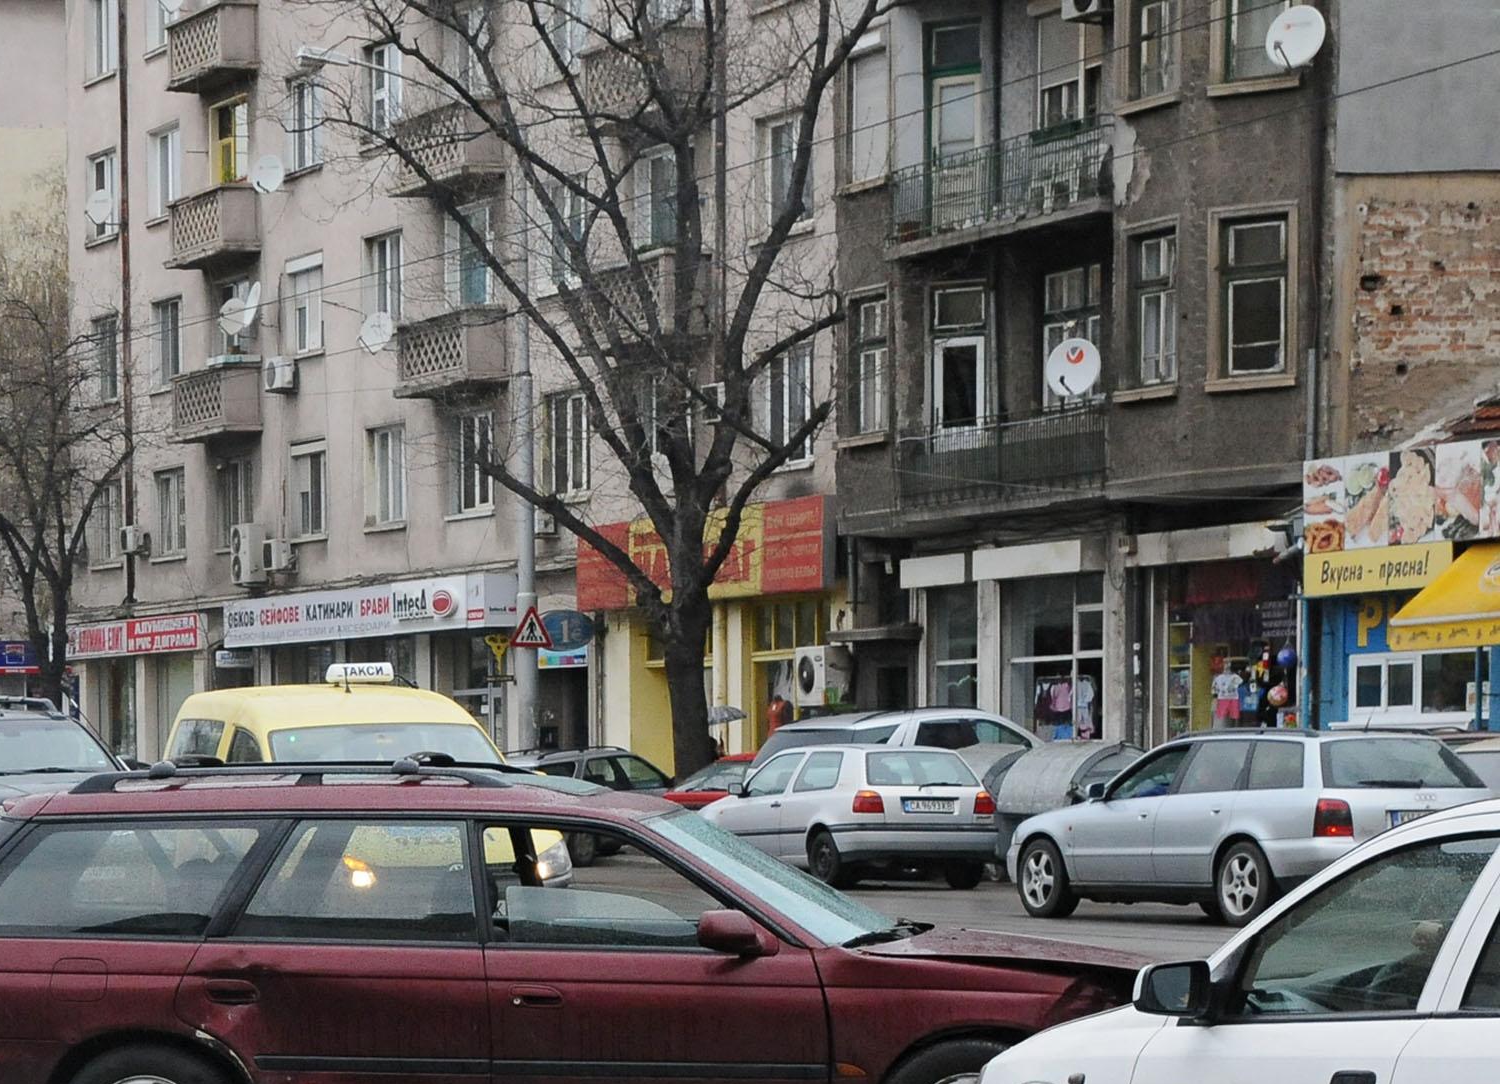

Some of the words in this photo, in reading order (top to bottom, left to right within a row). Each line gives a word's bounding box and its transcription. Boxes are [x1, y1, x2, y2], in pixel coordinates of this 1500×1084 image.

[1321, 560, 1363, 590] Вкусна
[1379, 550, 1430, 585] прясна!
[228, 610, 255, 628] ОБКОВ
[259, 603, 300, 626] СЕЙФОВЕ
[305, 601, 353, 621] КАТИНАРИ
[360, 597, 390, 617] БРАВИ
[287, 626, 326, 638] СИСТЕМИ
[337, 621, 390, 635] АКСЕСОАРИ
[152, 631, 196, 651] ДОГРАМА
[343, 665, 384, 676] ТАКСИ
